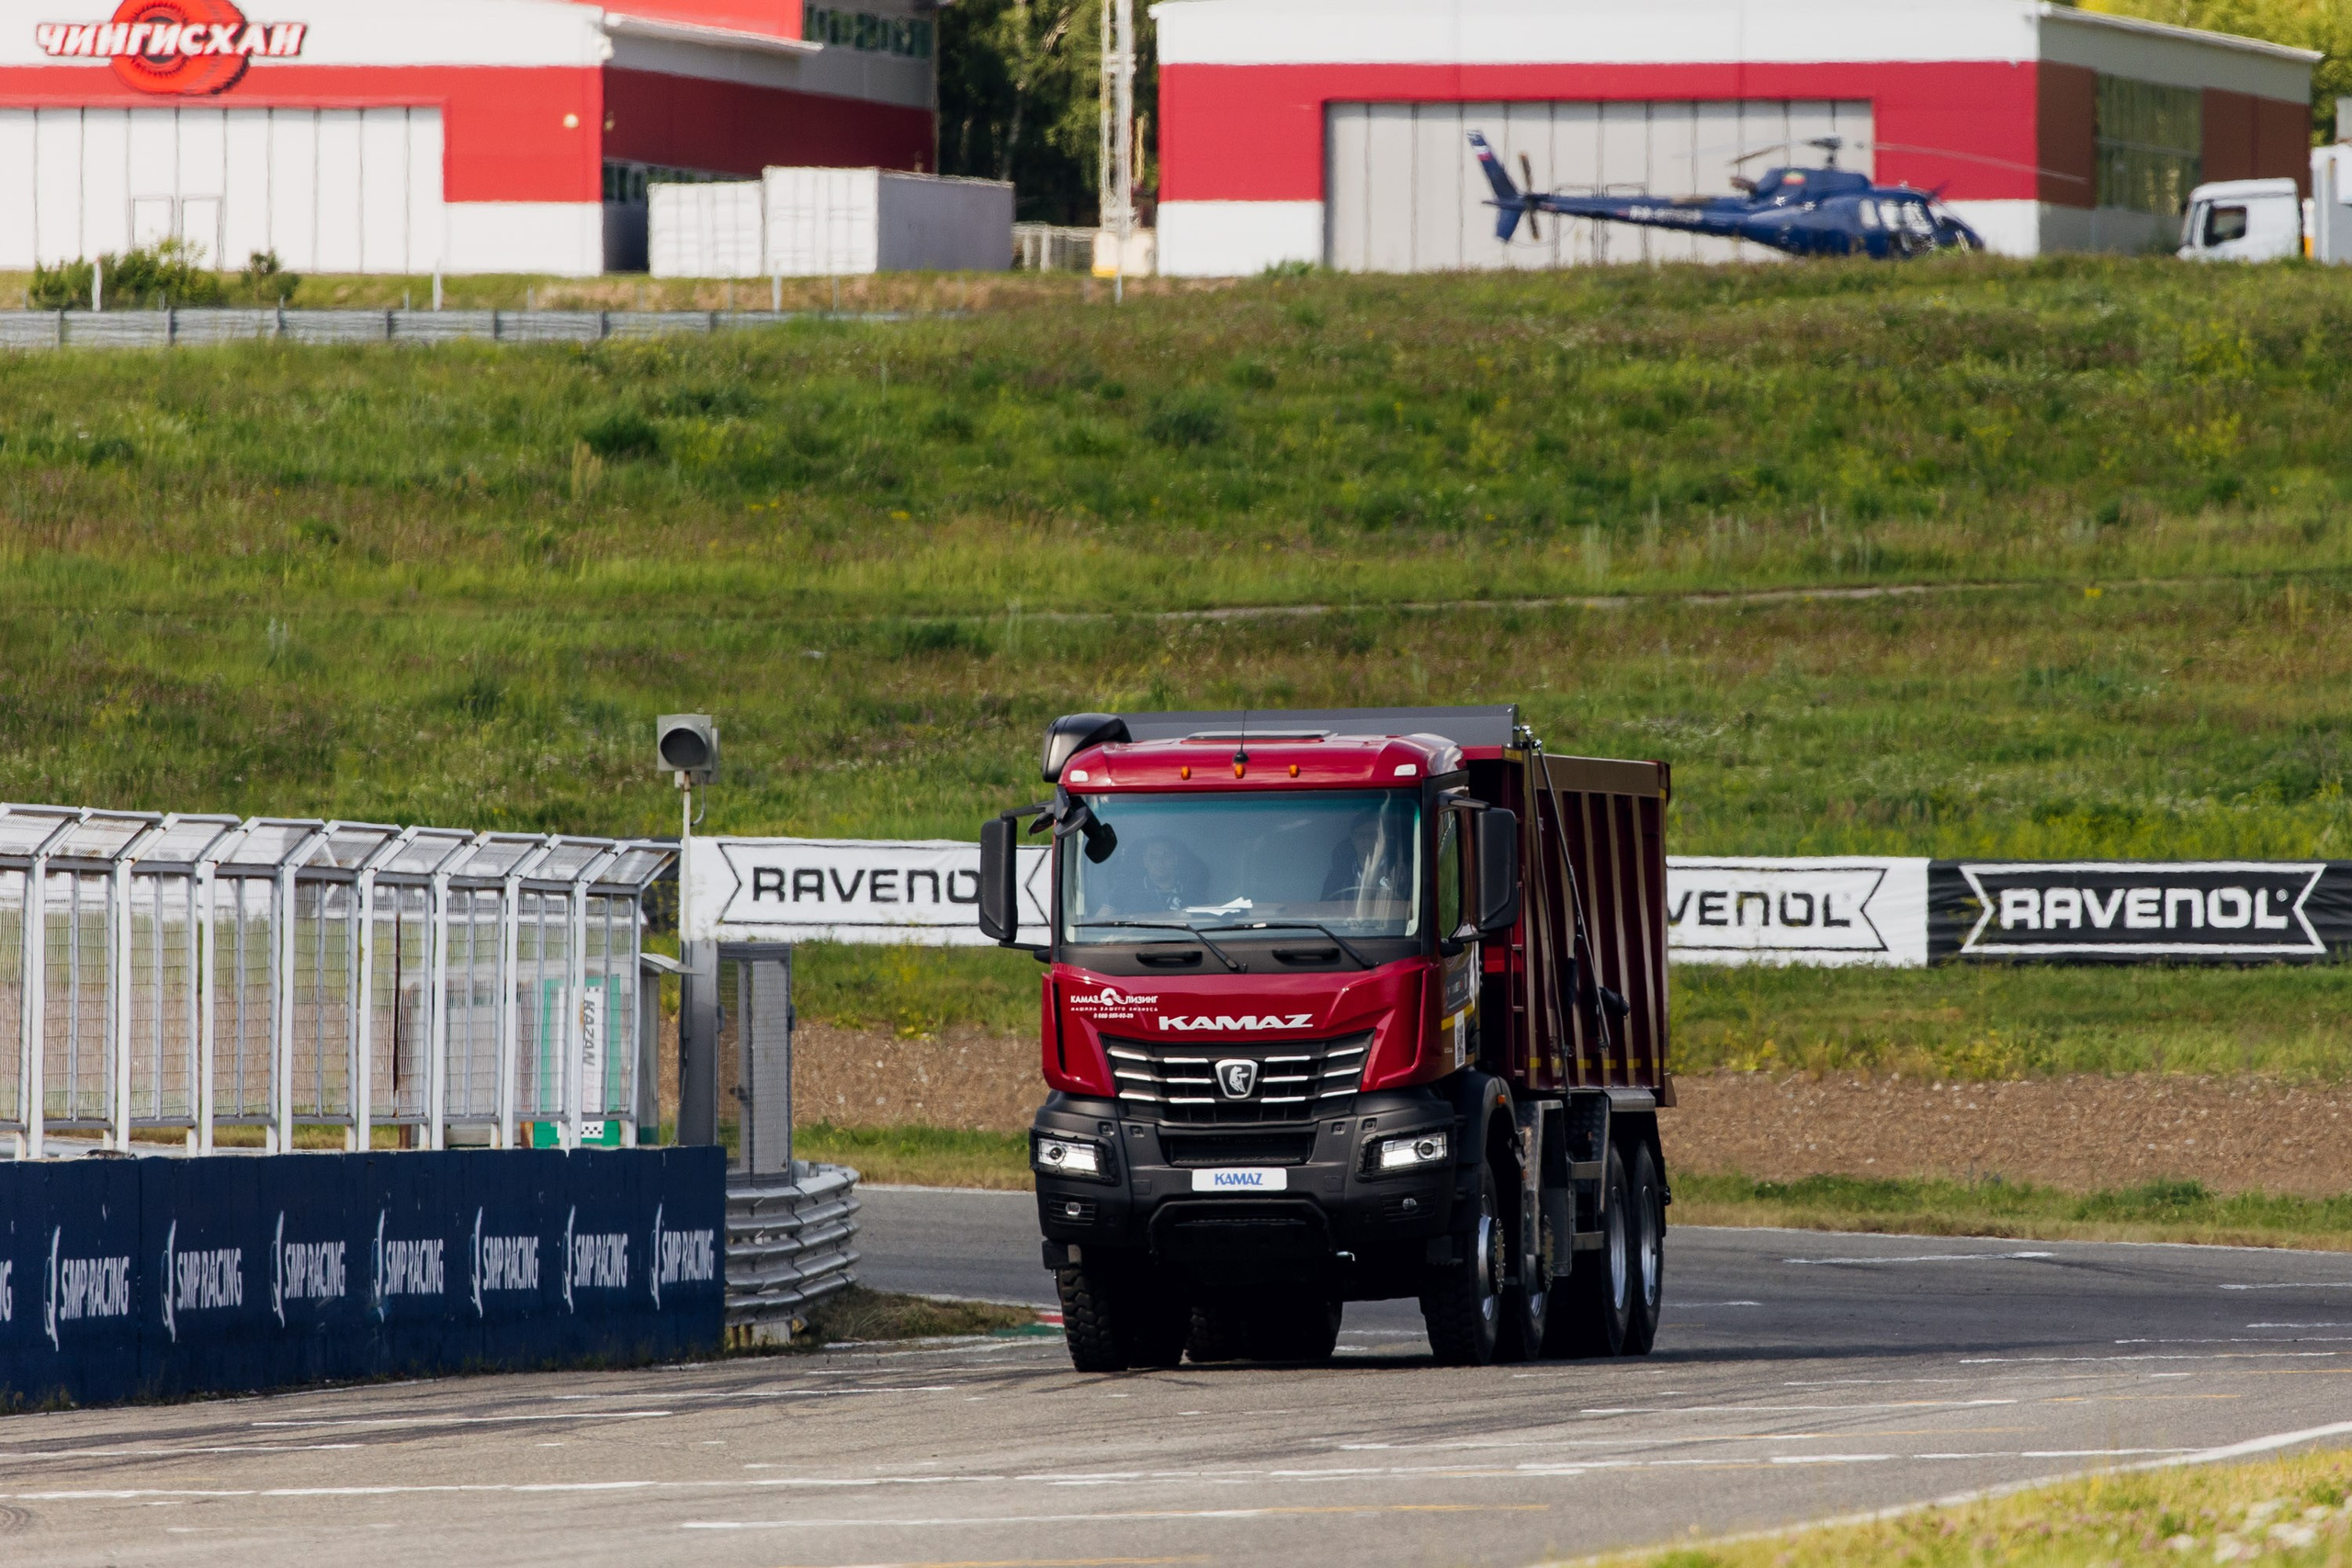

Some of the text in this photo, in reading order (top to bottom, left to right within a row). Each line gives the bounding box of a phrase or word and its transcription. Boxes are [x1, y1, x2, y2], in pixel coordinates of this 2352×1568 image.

[37, 22, 307, 56] ЧИНГИСХАН
[752, 867, 980, 904] RAVENO
[1668, 891, 1851, 927] VENOL
[1999, 887, 2289, 930] RAVENOL
[1070, 995, 1159, 1004] КАМАЗ ЛИЗИНГ
[1159, 1014, 1314, 1031] KAMAZ
[1215, 1173, 1263, 1186] KAMAZ
[177, 1248, 242, 1309] SMP RACING
[286, 1242, 345, 1298] SMP RACING
[385, 1239, 443, 1294] SMP RACING
[483, 1236, 538, 1290] SMP RACING
[574, 1234, 628, 1287] SMP RACING
[662, 1230, 713, 1283] SMP RACING
[61, 1259, 87, 1320] SMP
[87, 1257, 129, 1316] RACING
